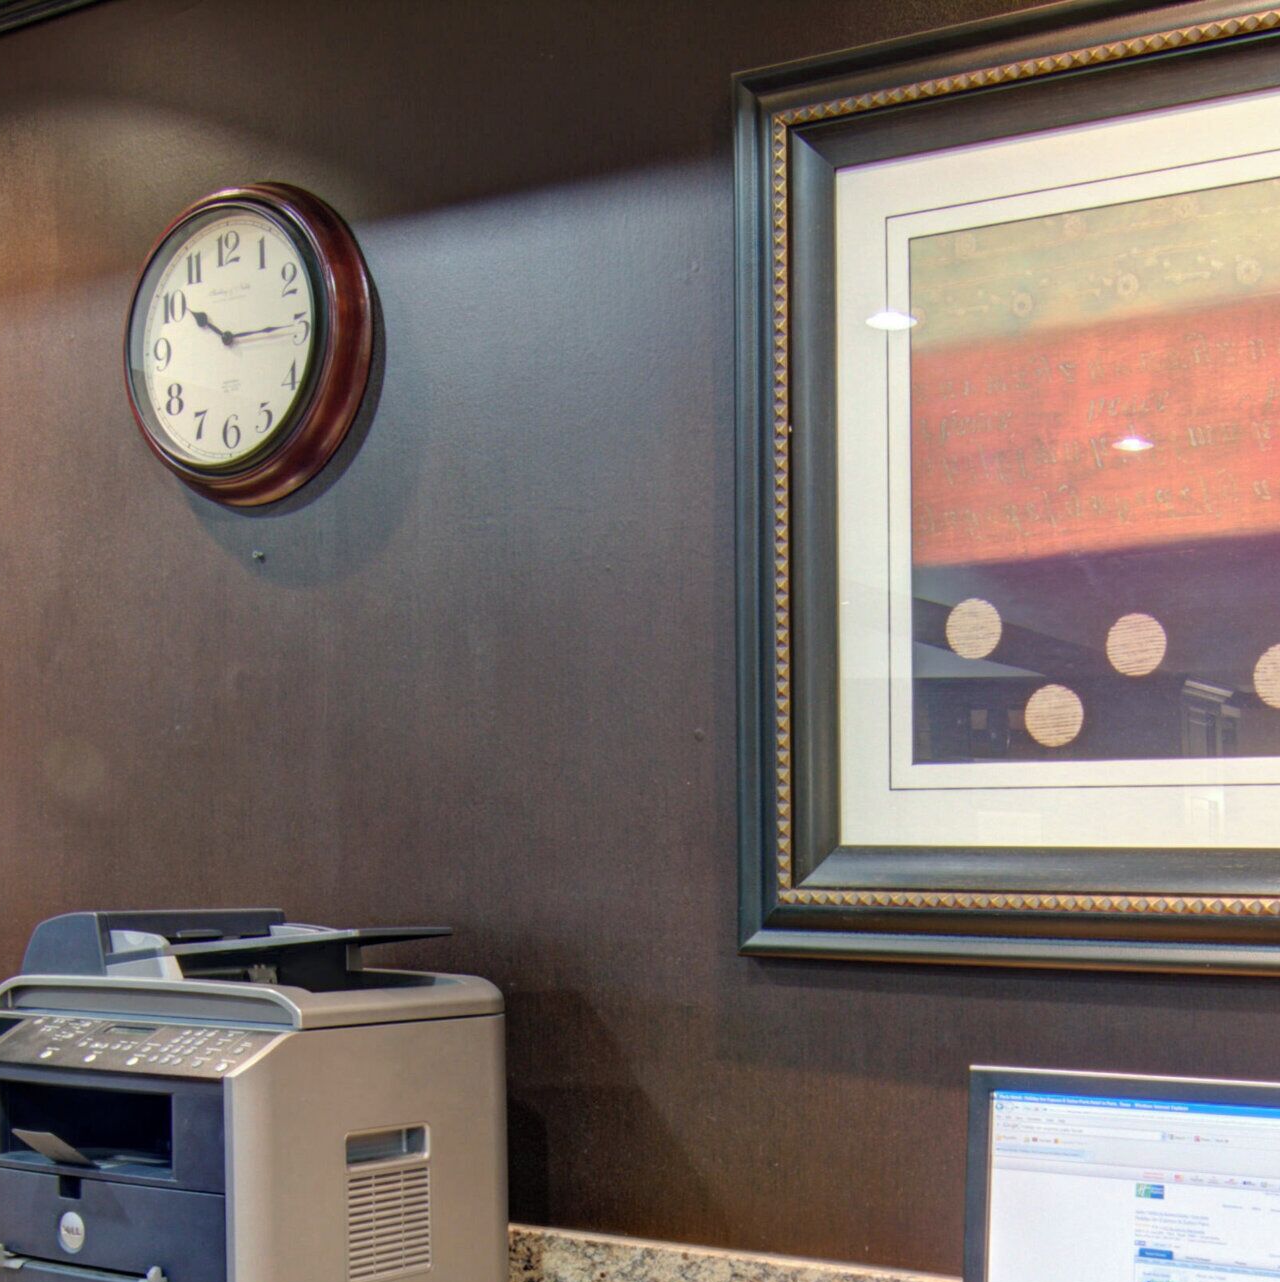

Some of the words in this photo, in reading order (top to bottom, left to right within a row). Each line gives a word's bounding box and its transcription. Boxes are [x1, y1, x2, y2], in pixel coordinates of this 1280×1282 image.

[216, 230, 241, 268] 12
[257, 235, 266, 270] 1
[186, 251, 203, 285] 11
[281, 262, 298, 298] 2
[163, 289, 187, 324] 10
[293, 311, 310, 346] 3
[153, 337, 171, 372] 9
[281, 359, 300, 391] 4
[165, 382, 184, 416] 8
[194, 409, 208, 441] 7
[222, 414, 241, 449] 6
[255, 402, 273, 434] 5
